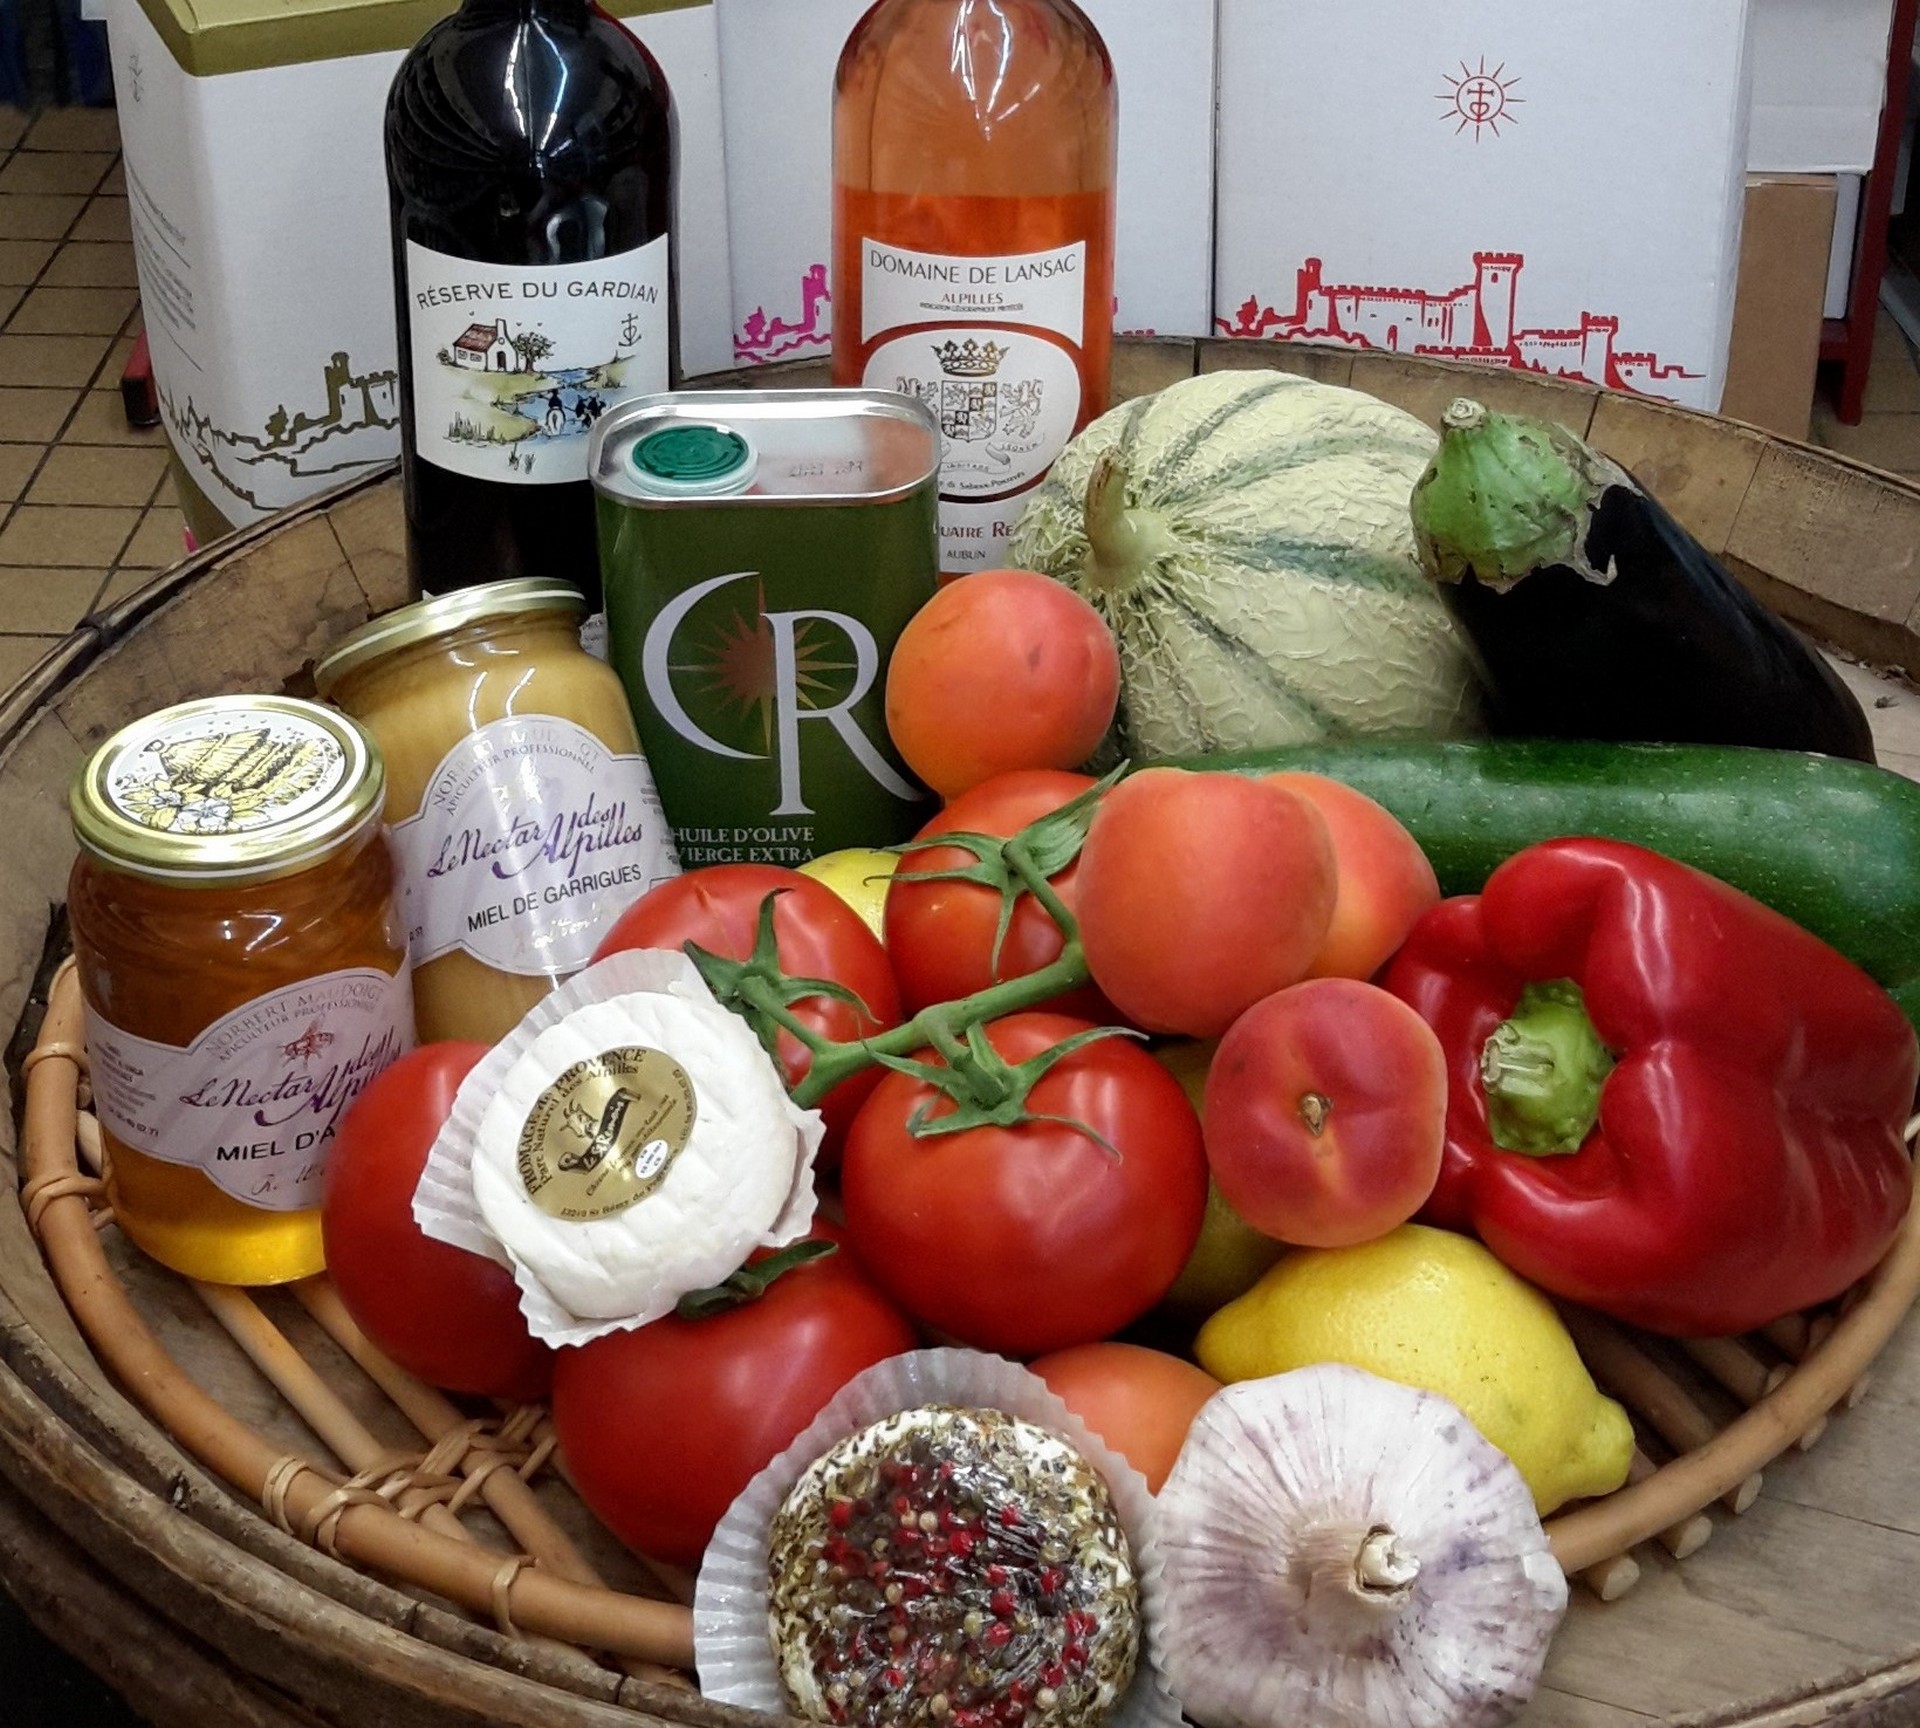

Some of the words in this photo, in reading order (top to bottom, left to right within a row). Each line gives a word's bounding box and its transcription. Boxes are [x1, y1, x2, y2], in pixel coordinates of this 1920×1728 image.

[870, 249, 960, 284] DOMAINE
[969, 266, 997, 285] DE
[1005, 253, 1076, 283] LANSAC
[416, 282, 513, 310] RÉSERVE
[522, 281, 558, 298] DU
[567, 281, 658, 304] GARDIAN
[941, 292, 1003, 304] ALPILLES
[642, 571, 928, 816] CR
[457, 815, 543, 866] Nectar
[734, 826, 815, 843] D'OLIVE
[750, 848, 814, 862] EXTRA
[467, 904, 506, 932] MIEL
[513, 893, 539, 916] DE
[543, 863, 642, 902] GARRIGUES
[554, 1048, 647, 1095] PROVENCE
[216, 1140, 286, 1161] MIEL
[295, 1125, 337, 1151] D'A
